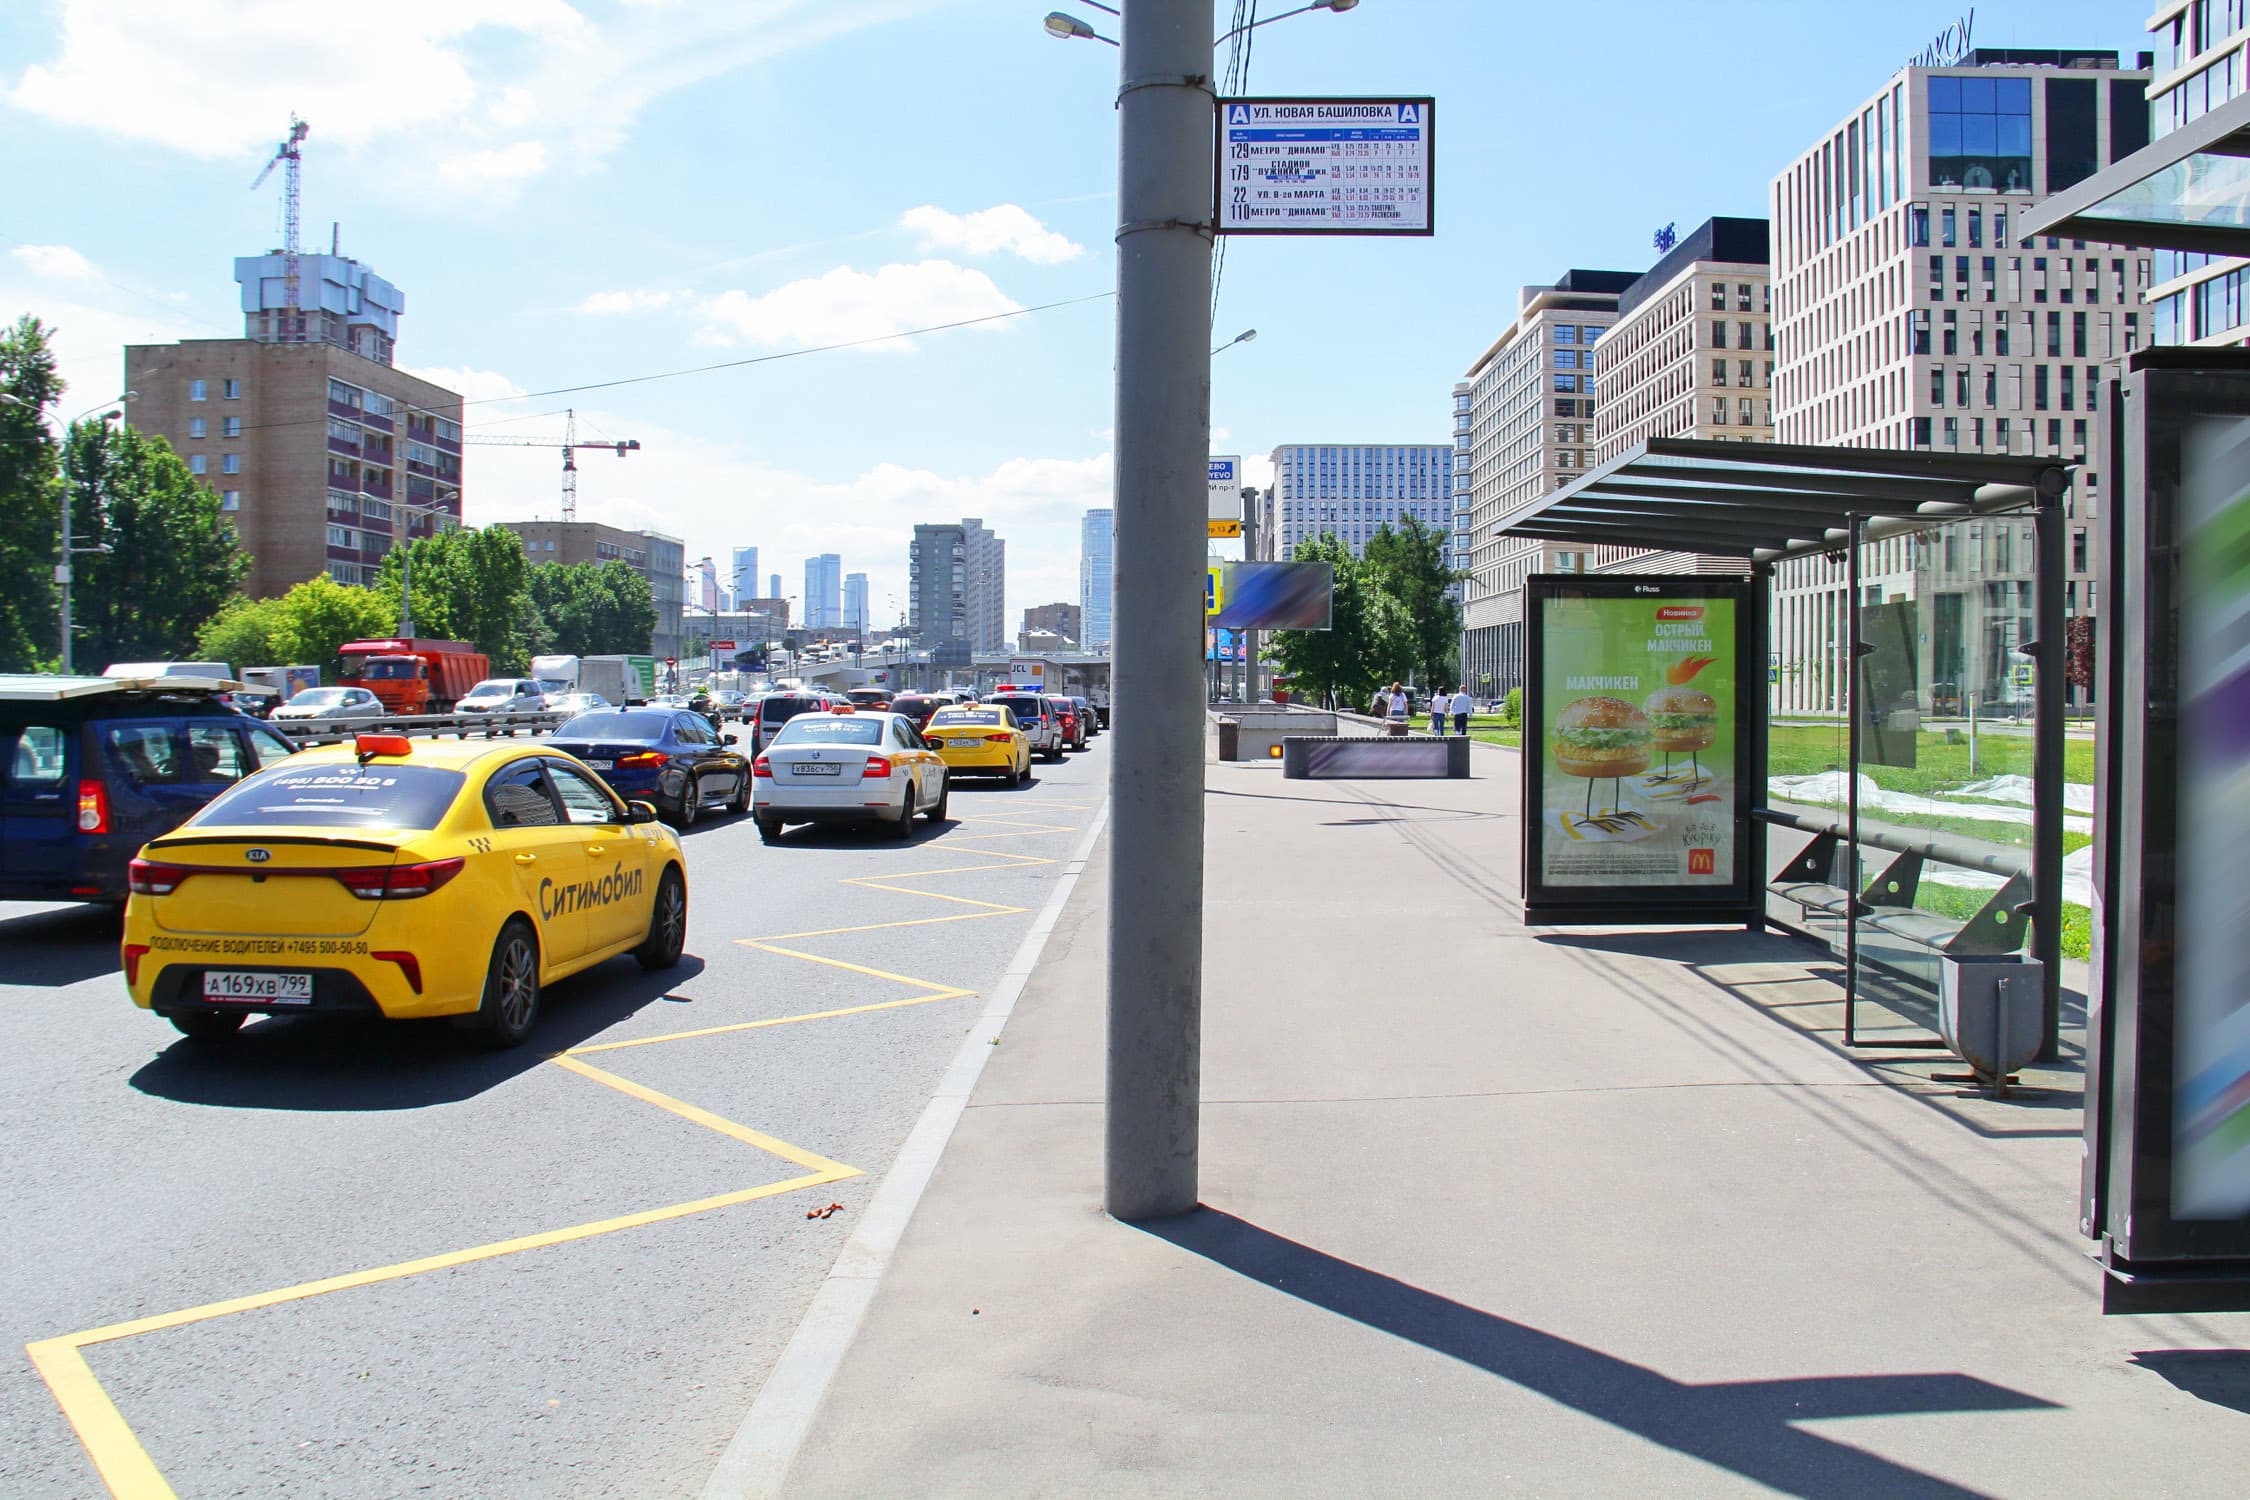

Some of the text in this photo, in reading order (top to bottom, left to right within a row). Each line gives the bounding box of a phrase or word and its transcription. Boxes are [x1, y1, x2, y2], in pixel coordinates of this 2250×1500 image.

[1254, 106, 1393, 118] УЛ. НОВАЯ БАШИЛОВКА
[1250, 147, 1280, 155] МЕТРО
[1272, 160, 1310, 168] СТАДИОН
[1234, 187, 1247, 203] 22
[1294, 190, 1325, 198] МАРТА
[1231, 204, 1249, 220] 110
[1251, 208, 1281, 216] МЕТРО
[1656, 621, 1704, 637] ОСТРЫЙ
[1647, 639, 1712, 653] МАКЧИКЕН
[1011, 664, 1027, 673] JCL
[1566, 675, 1638, 690] МАКЧИКЕН
[248, 850, 269, 861] KIA
[540, 860, 642, 922] Ситимобил
[151, 935, 369, 956] ПОДКЛЮЧЕНИЕ ВОДИТЕЛЕЙ +7495 500-50-50
[280, 975, 308, 991] 799
